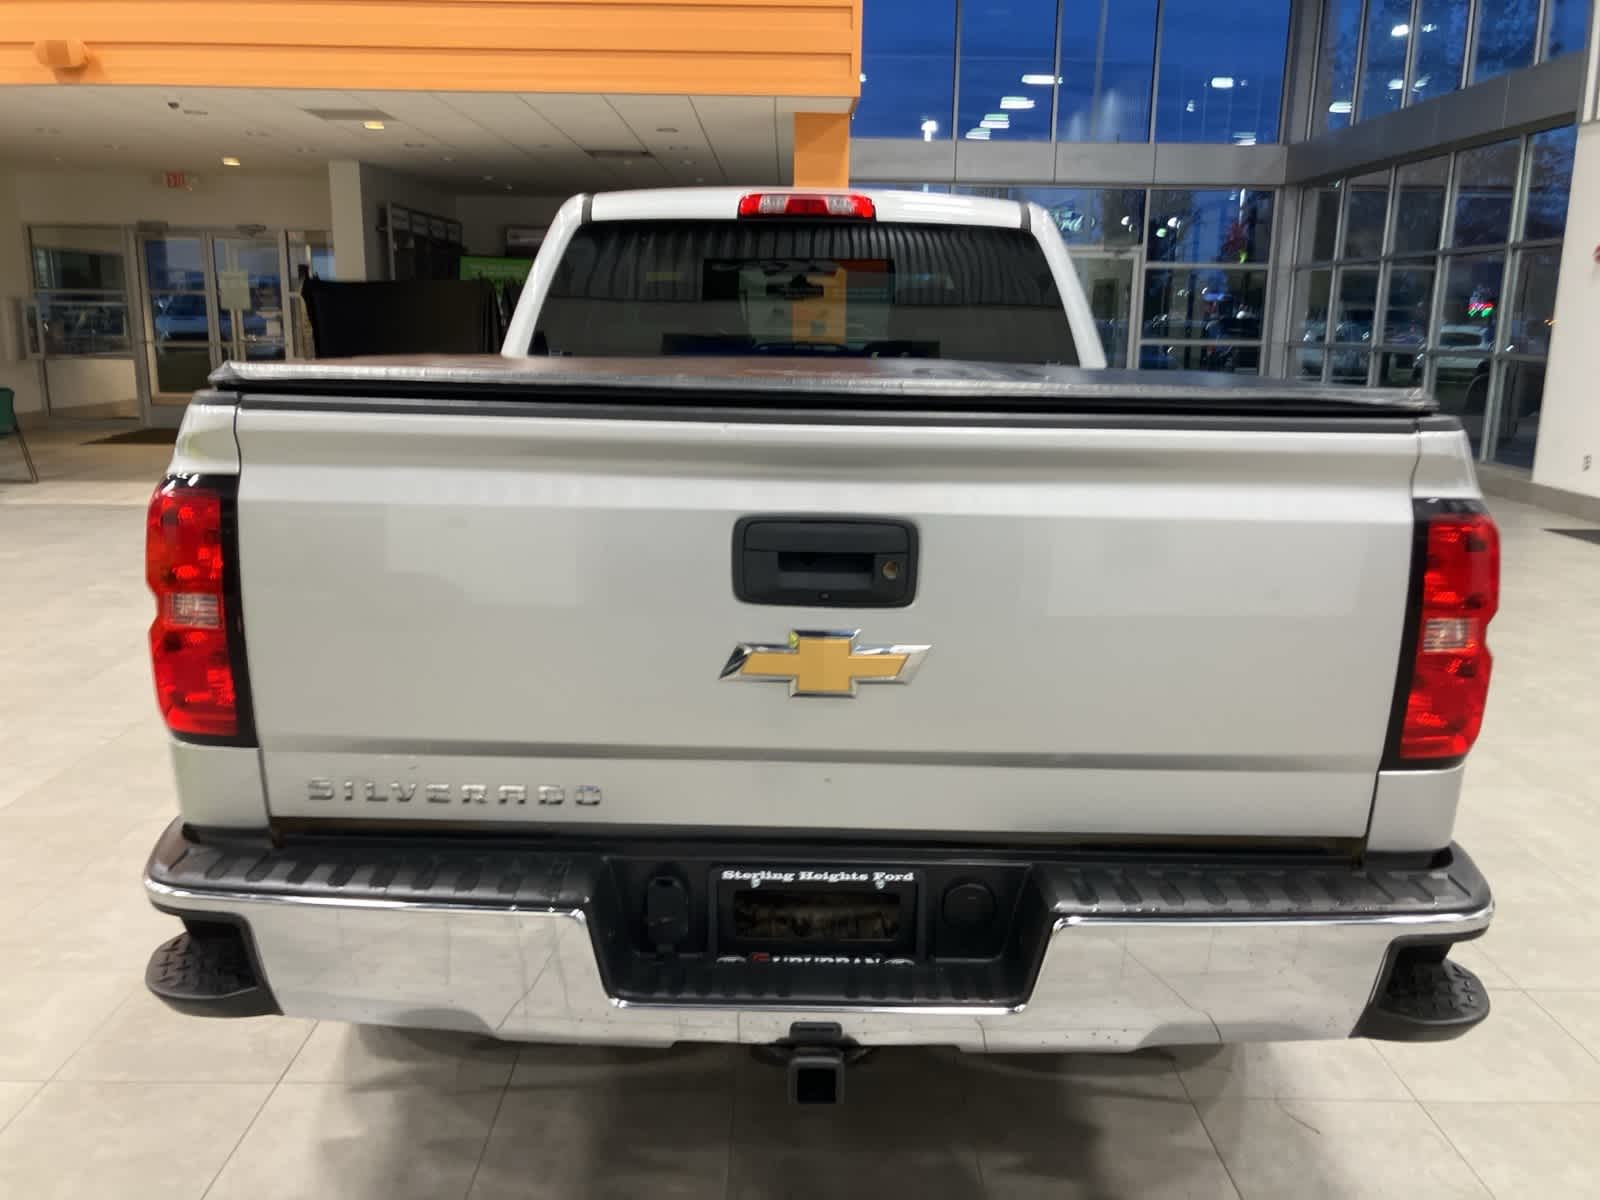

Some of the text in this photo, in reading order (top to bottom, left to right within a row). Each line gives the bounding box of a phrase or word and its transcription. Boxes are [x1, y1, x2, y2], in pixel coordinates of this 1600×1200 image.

[307, 777, 601, 806] SILVERADO
[721, 870, 915, 883] Sterling Heights Ford
